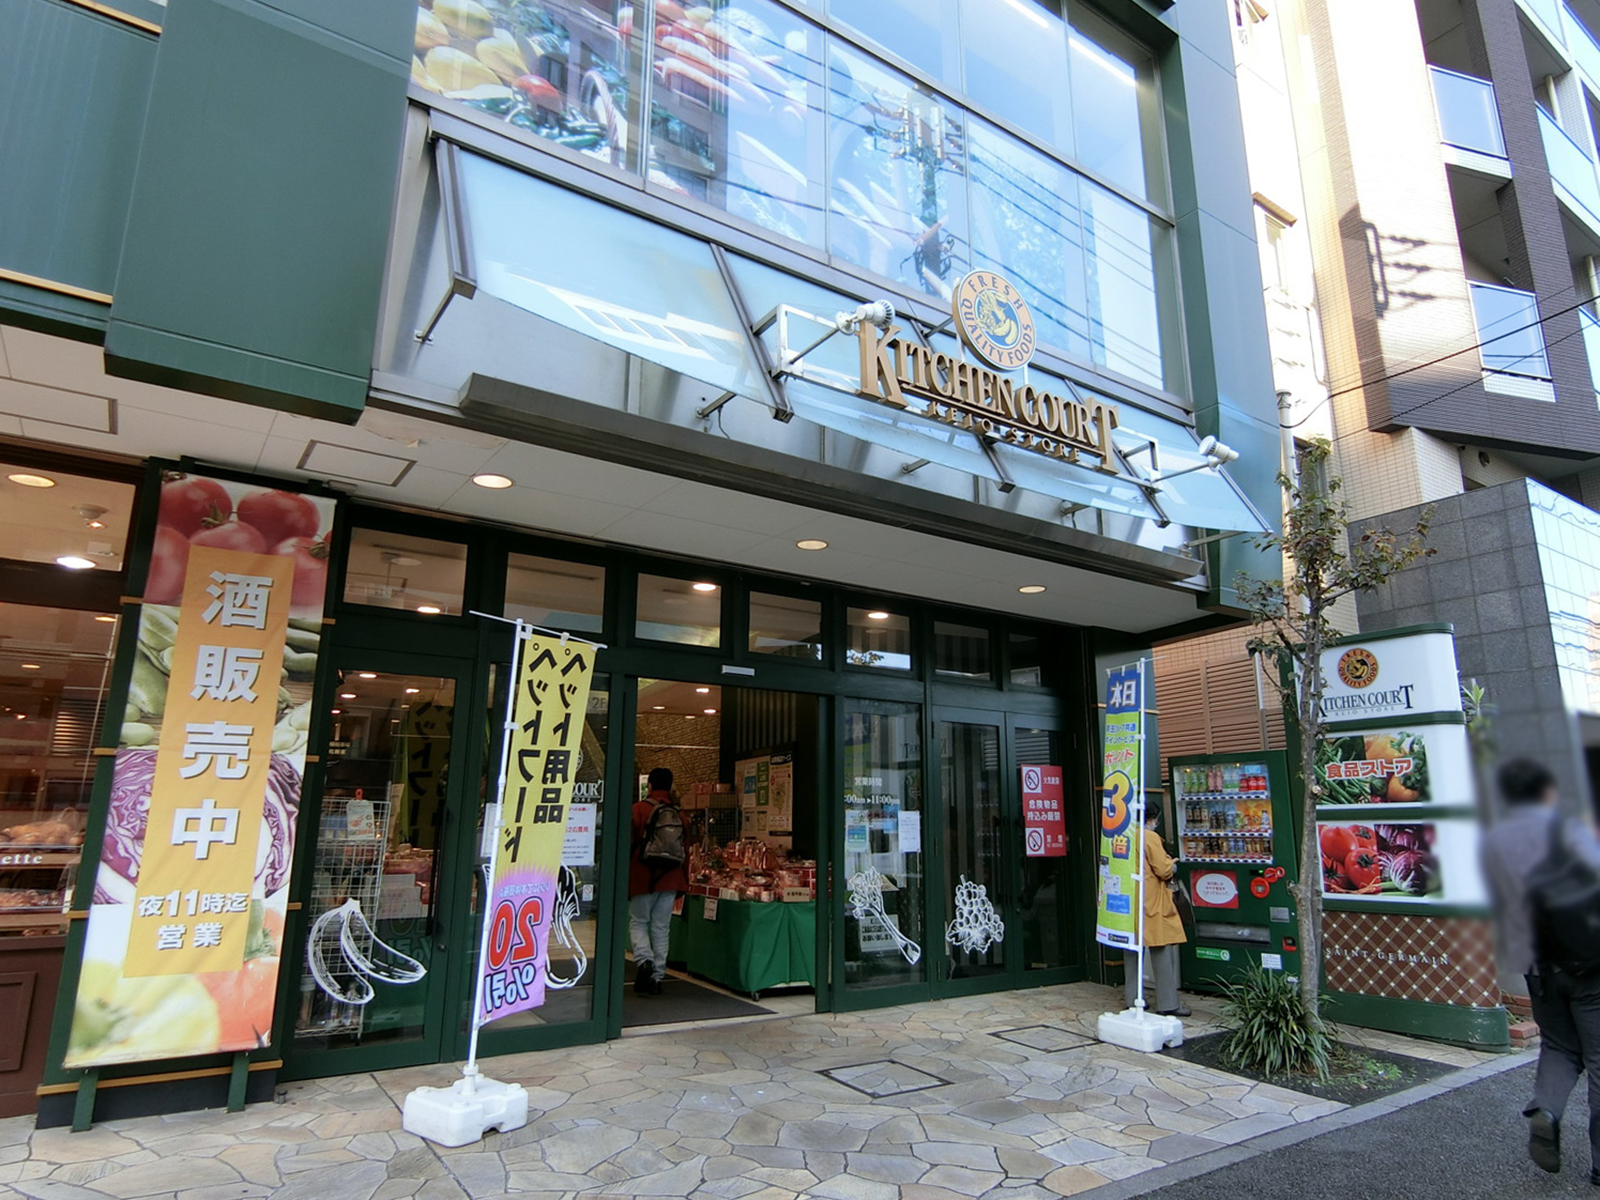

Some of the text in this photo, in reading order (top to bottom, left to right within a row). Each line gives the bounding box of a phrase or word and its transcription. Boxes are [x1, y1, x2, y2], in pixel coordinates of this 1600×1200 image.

[967, 275, 1024, 310] FRESH
[961, 298, 1033, 365] QUALITY FOODS
[855, 320, 1120, 475] KITCHEN COURT
[921, 400, 1081, 463] KEIO STORE
[1364, 706, 1394, 714] STORE
[1367, 684, 1414, 709] COURT
[170, 569, 273, 860] 酒販売中
[1325, 757, 1413, 780] 食品ストア
[1028, 799, 1058, 810] 危険物品
[1101, 770, 1133, 838] 3
[1112, 835, 1130, 859] 倍
[138, 889, 248, 918] 夜11時迄
[157, 922, 223, 950] 営業
